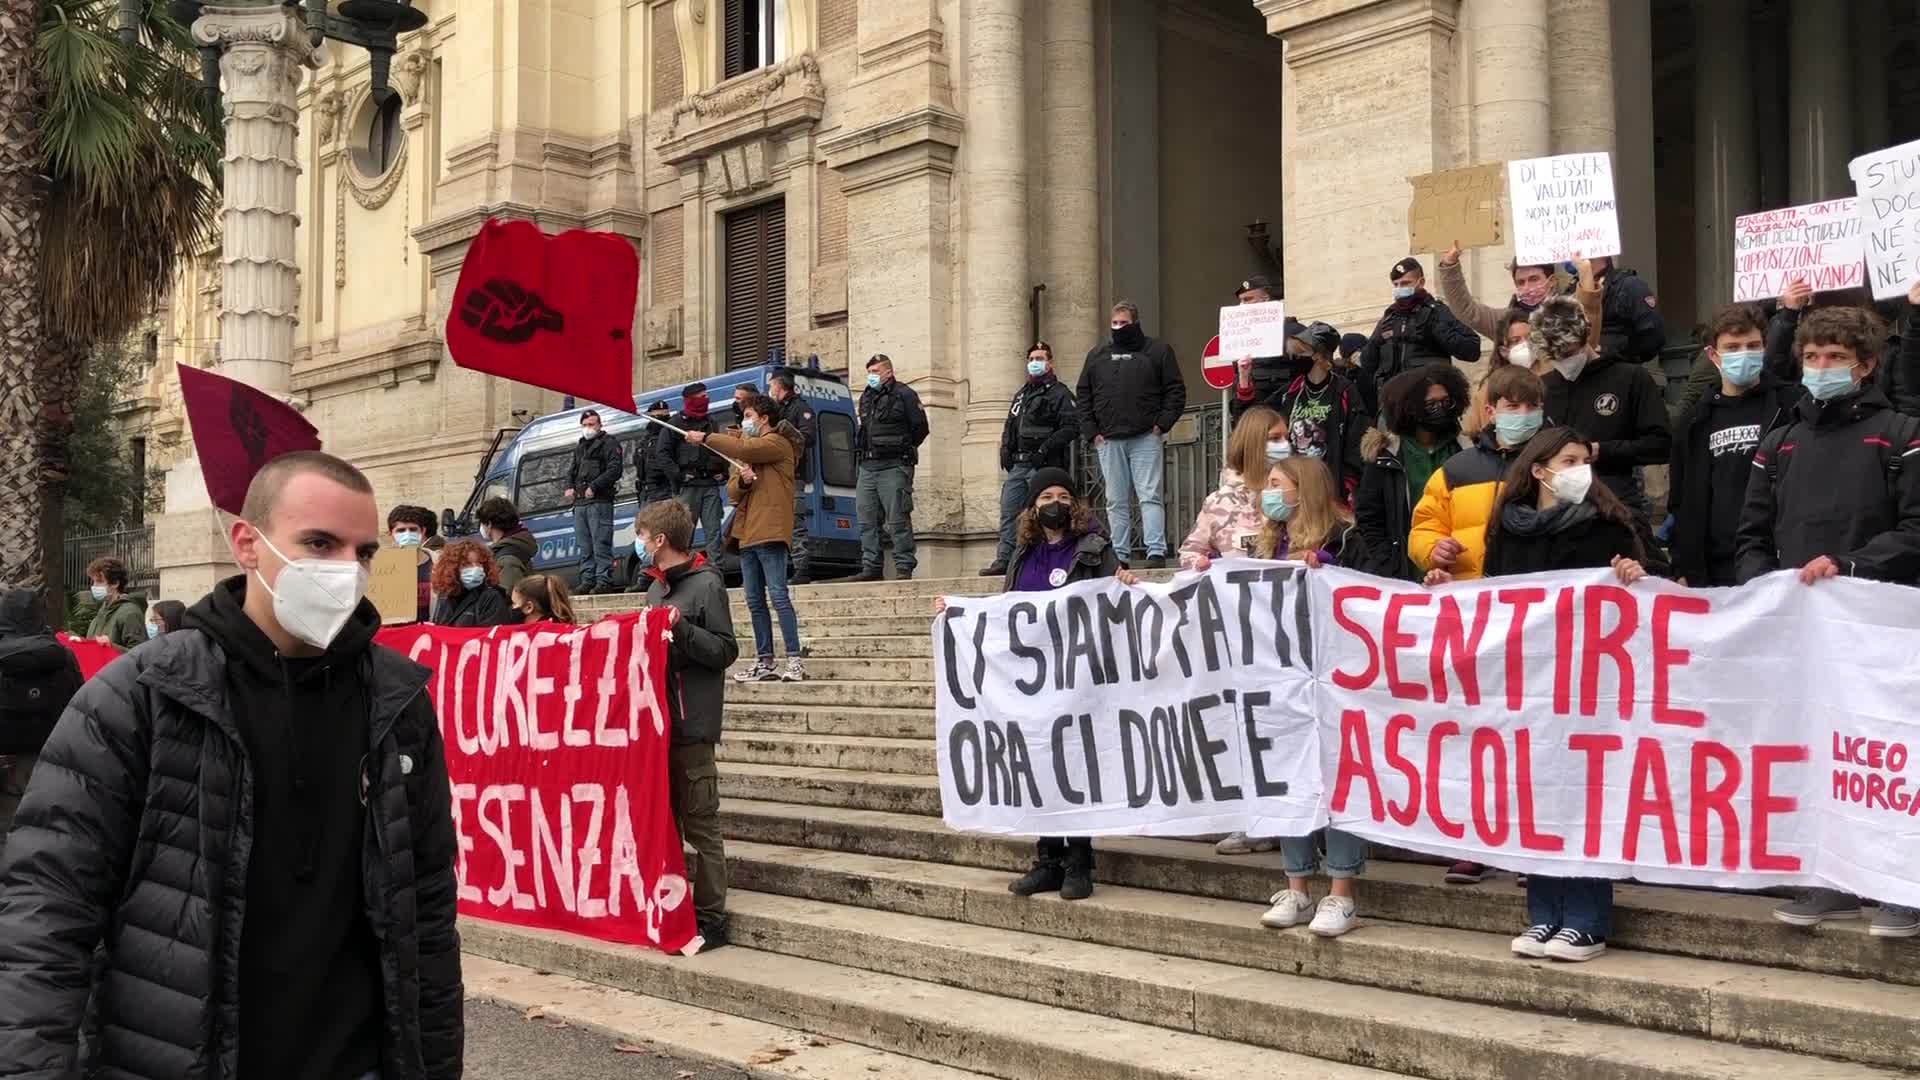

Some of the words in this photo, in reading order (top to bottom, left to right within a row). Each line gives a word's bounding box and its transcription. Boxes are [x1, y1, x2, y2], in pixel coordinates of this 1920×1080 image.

[1520, 162, 1537, 183] DI
[1866, 154, 1920, 188] STU
[1533, 178, 1593, 201] VALUTATI
[1525, 205, 1551, 220] NON
[1803, 217, 1863, 245] STUDENTI
[1872, 218, 1905, 254] NÉ
[1736, 243, 1833, 273] L'OPPOSIZIONE
[1877, 252, 1907, 288] NÉ
[1737, 272, 1771, 302] STA
[794, 383, 840, 402] OLIZIA
[944, 606, 987, 710] CI
[1008, 591, 1164, 696] SIAMO
[1167, 567, 1313, 678] FATTI
[1331, 584, 1712, 728] SENTIRE
[949, 720, 1043, 807] ORA
[1051, 713, 1103, 804] CI
[1832, 730, 1908, 772] LICEO
[1329, 708, 1809, 873] ASCOLTARE
